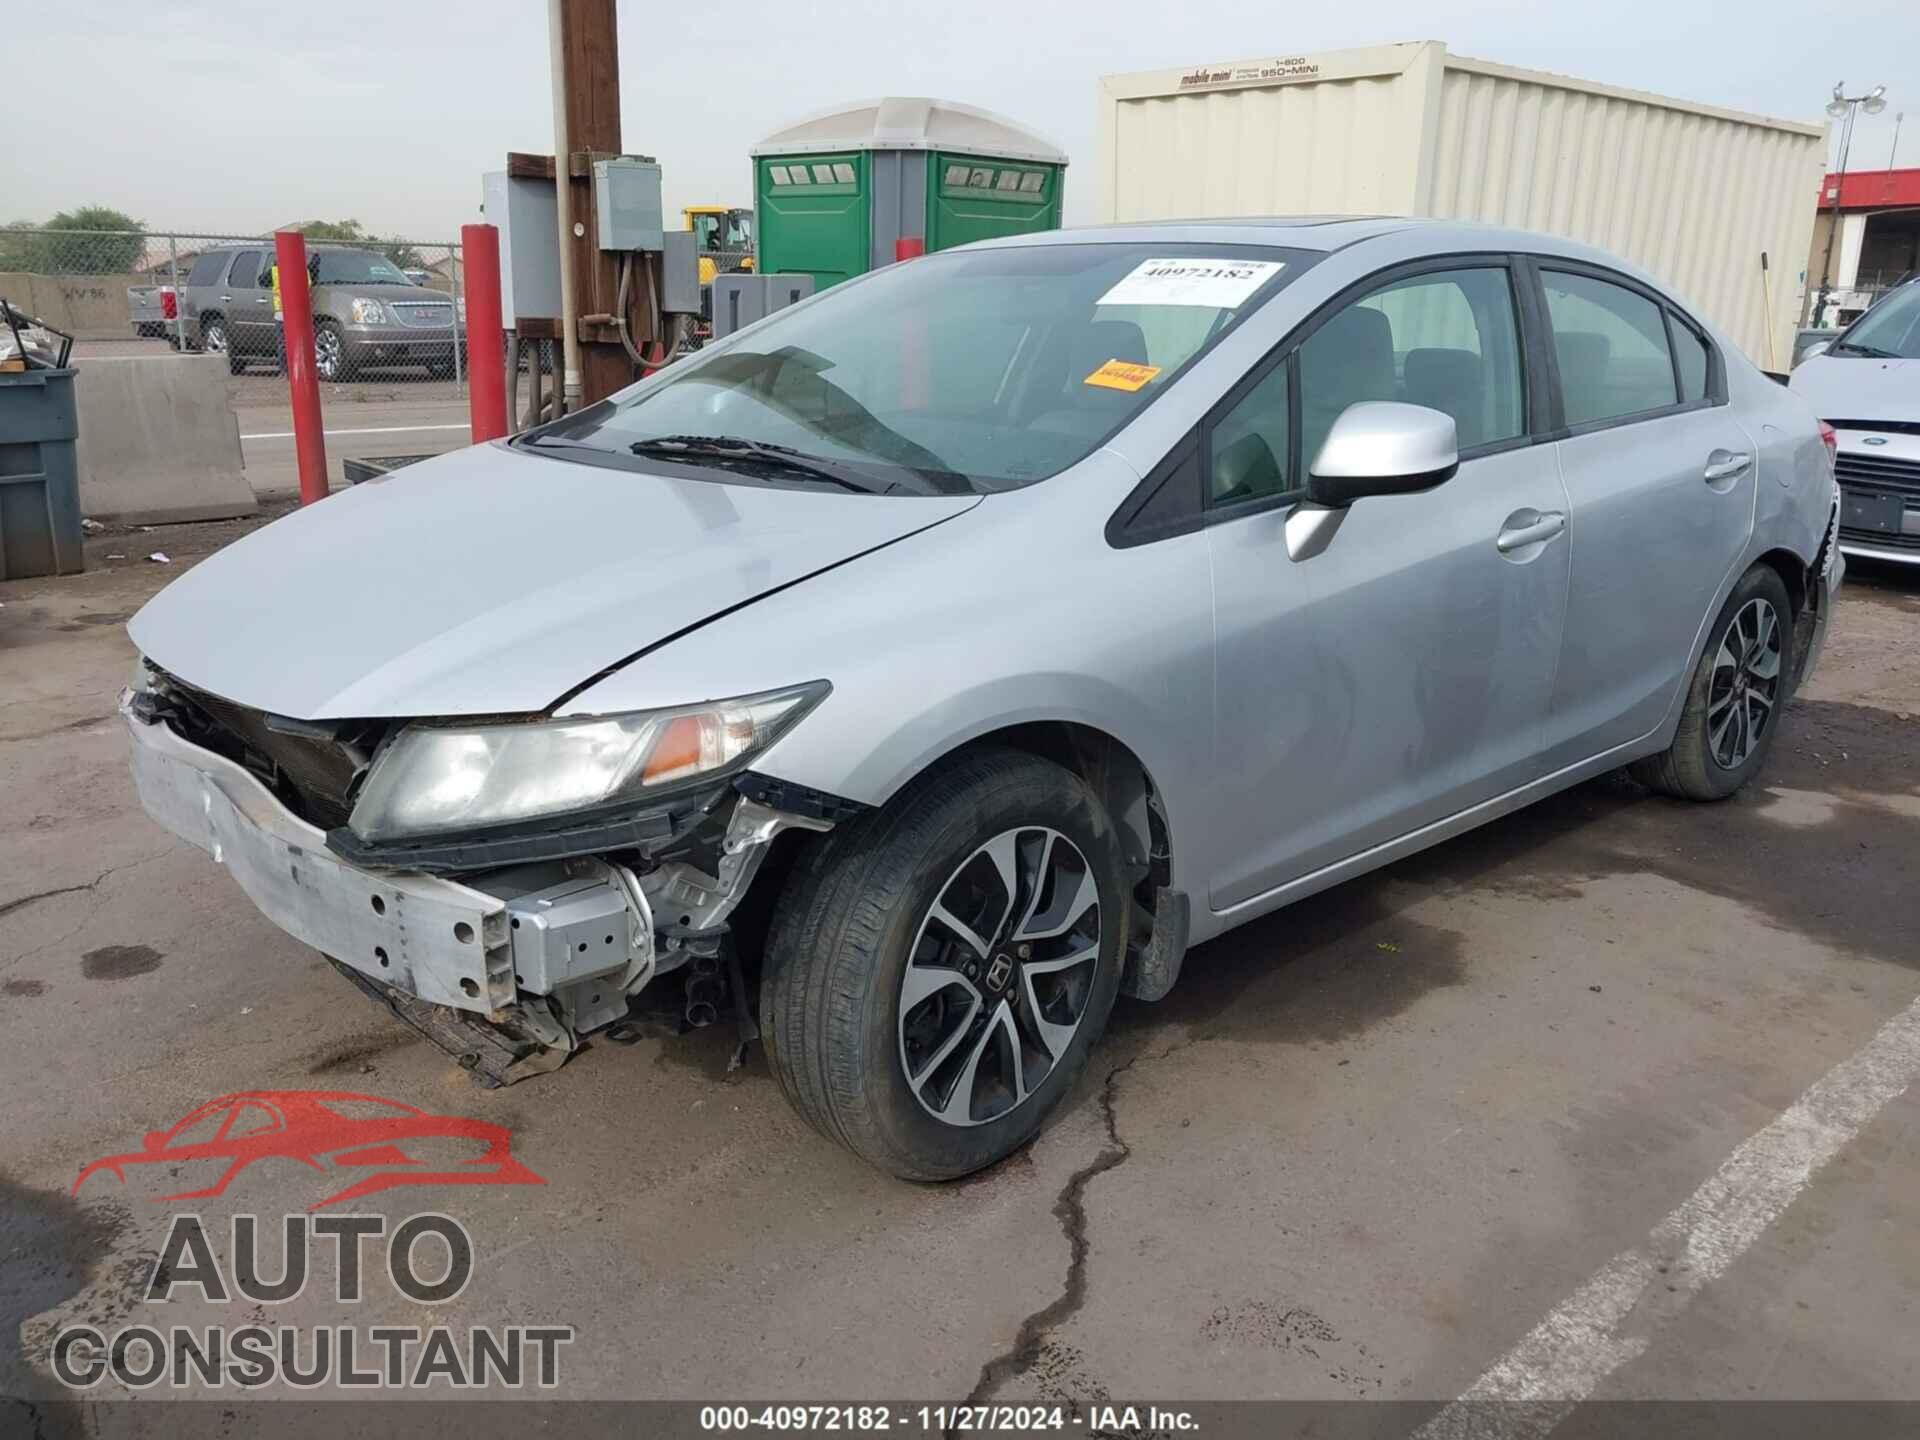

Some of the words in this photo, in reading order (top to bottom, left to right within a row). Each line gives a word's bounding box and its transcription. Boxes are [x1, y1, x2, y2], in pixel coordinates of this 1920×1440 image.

[1276, 57, 1305, 66] 1-800
[1211, 68, 1232, 82] mini
[1261, 65, 1318, 77] 950-MINI
[1144, 267, 1254, 280] 40972182
